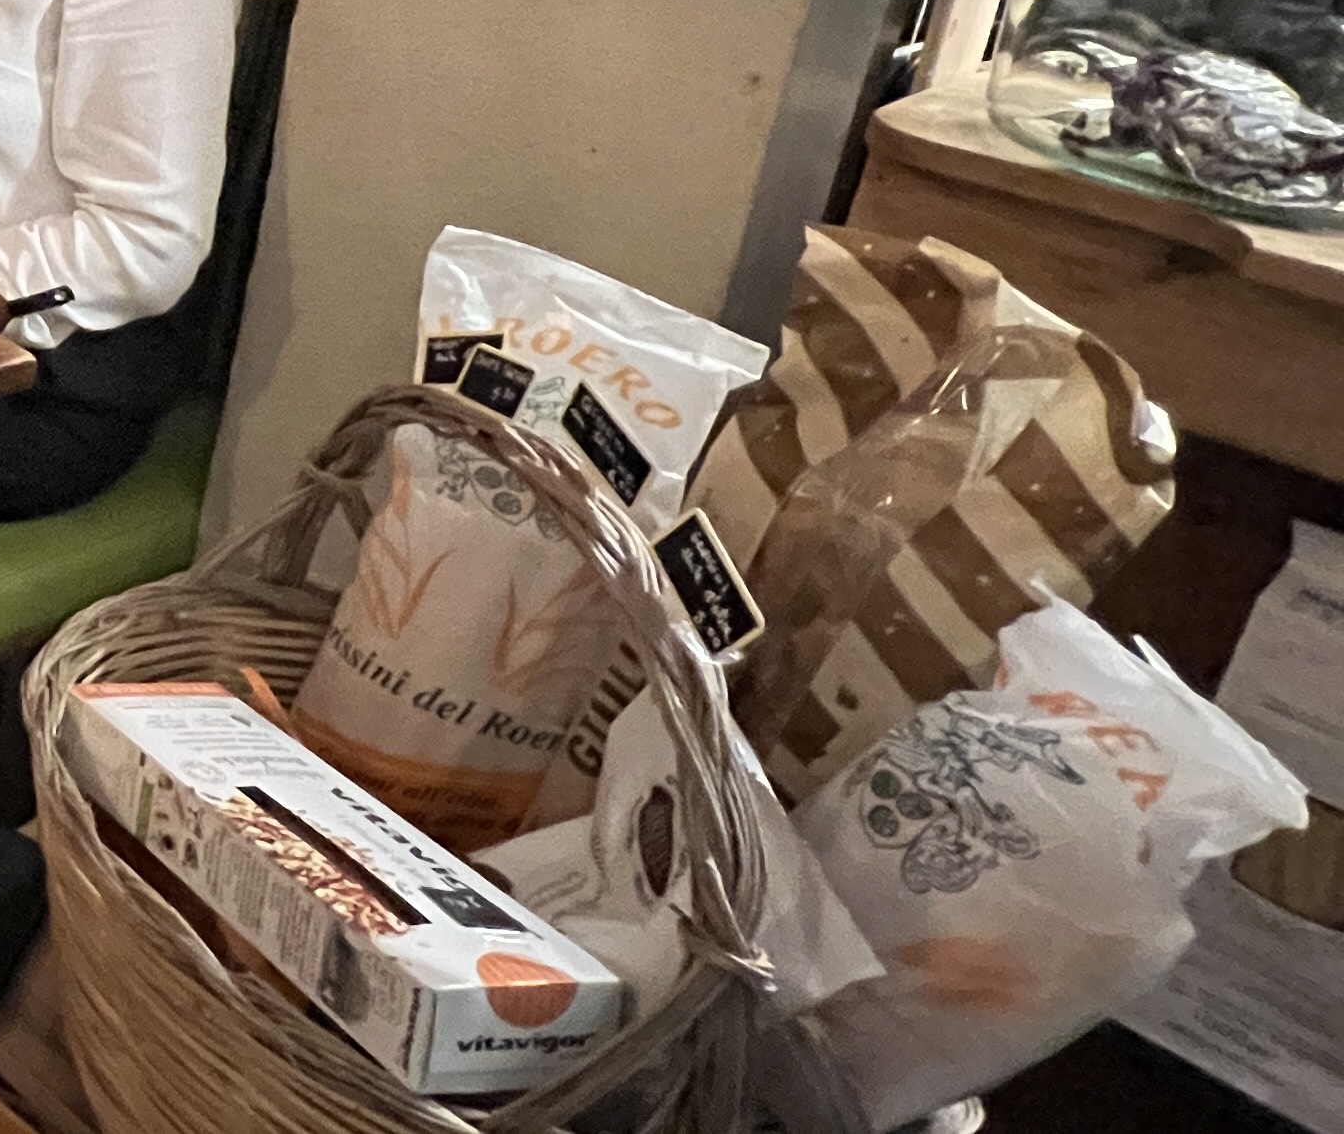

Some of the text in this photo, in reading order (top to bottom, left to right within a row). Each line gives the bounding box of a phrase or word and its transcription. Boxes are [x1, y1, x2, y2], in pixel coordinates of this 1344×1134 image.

[328, 625, 566, 752] rissini del Roer
[456, 1030, 594, 1056] vitavigor
